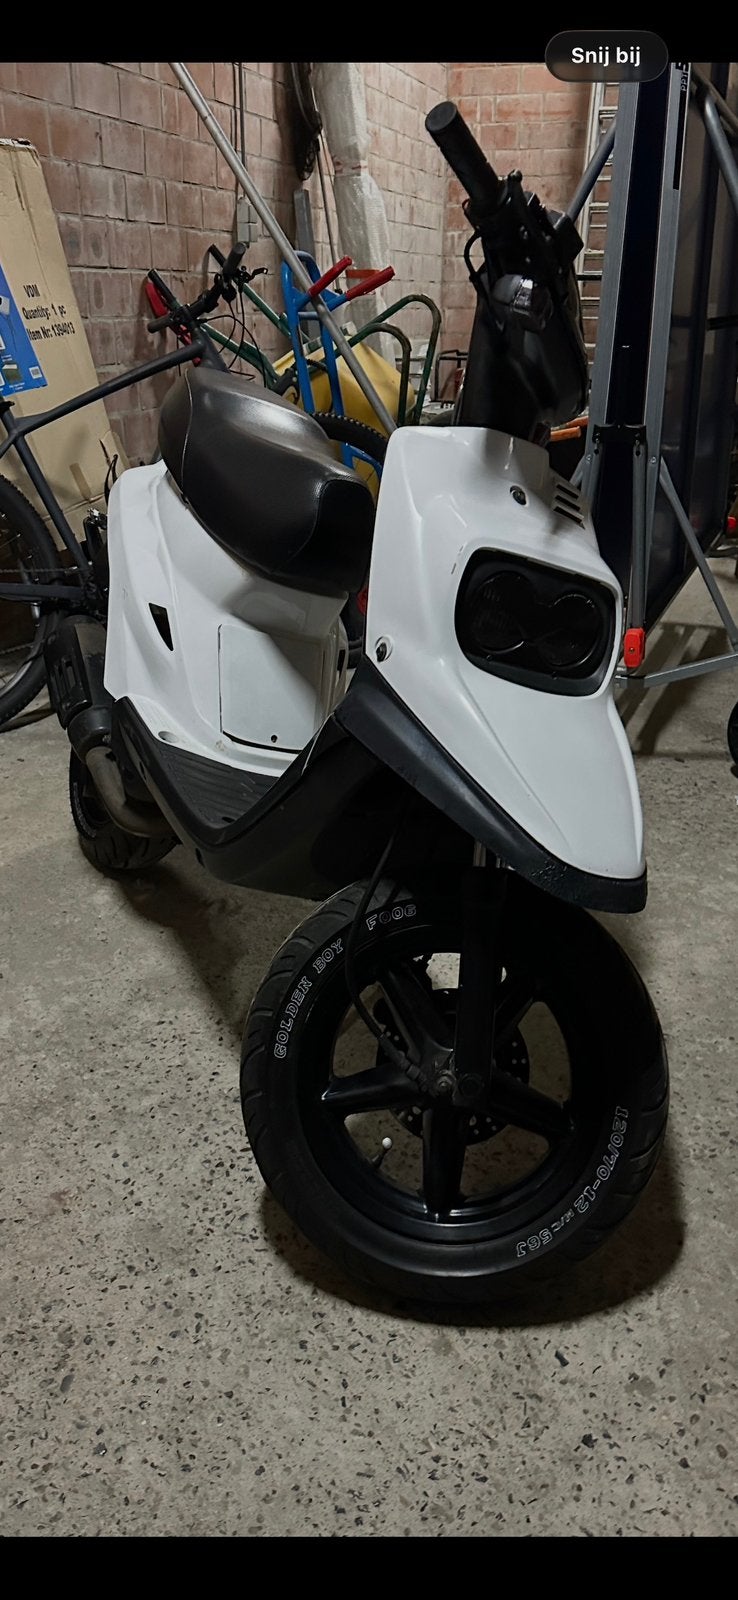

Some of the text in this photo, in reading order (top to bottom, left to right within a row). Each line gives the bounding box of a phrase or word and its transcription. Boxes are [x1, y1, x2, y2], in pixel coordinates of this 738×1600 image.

[23, 284, 40, 298] VDM
[22, 303, 66, 320] Quantity: 1 pc
[26, 328, 42, 340] Item
[274, 975, 313, 1059] GOLDEN
[312, 938, 344, 974] BOY
[574, 1105, 629, 1213] 120/70-12
[516, 1228, 553, 1258] 56J
